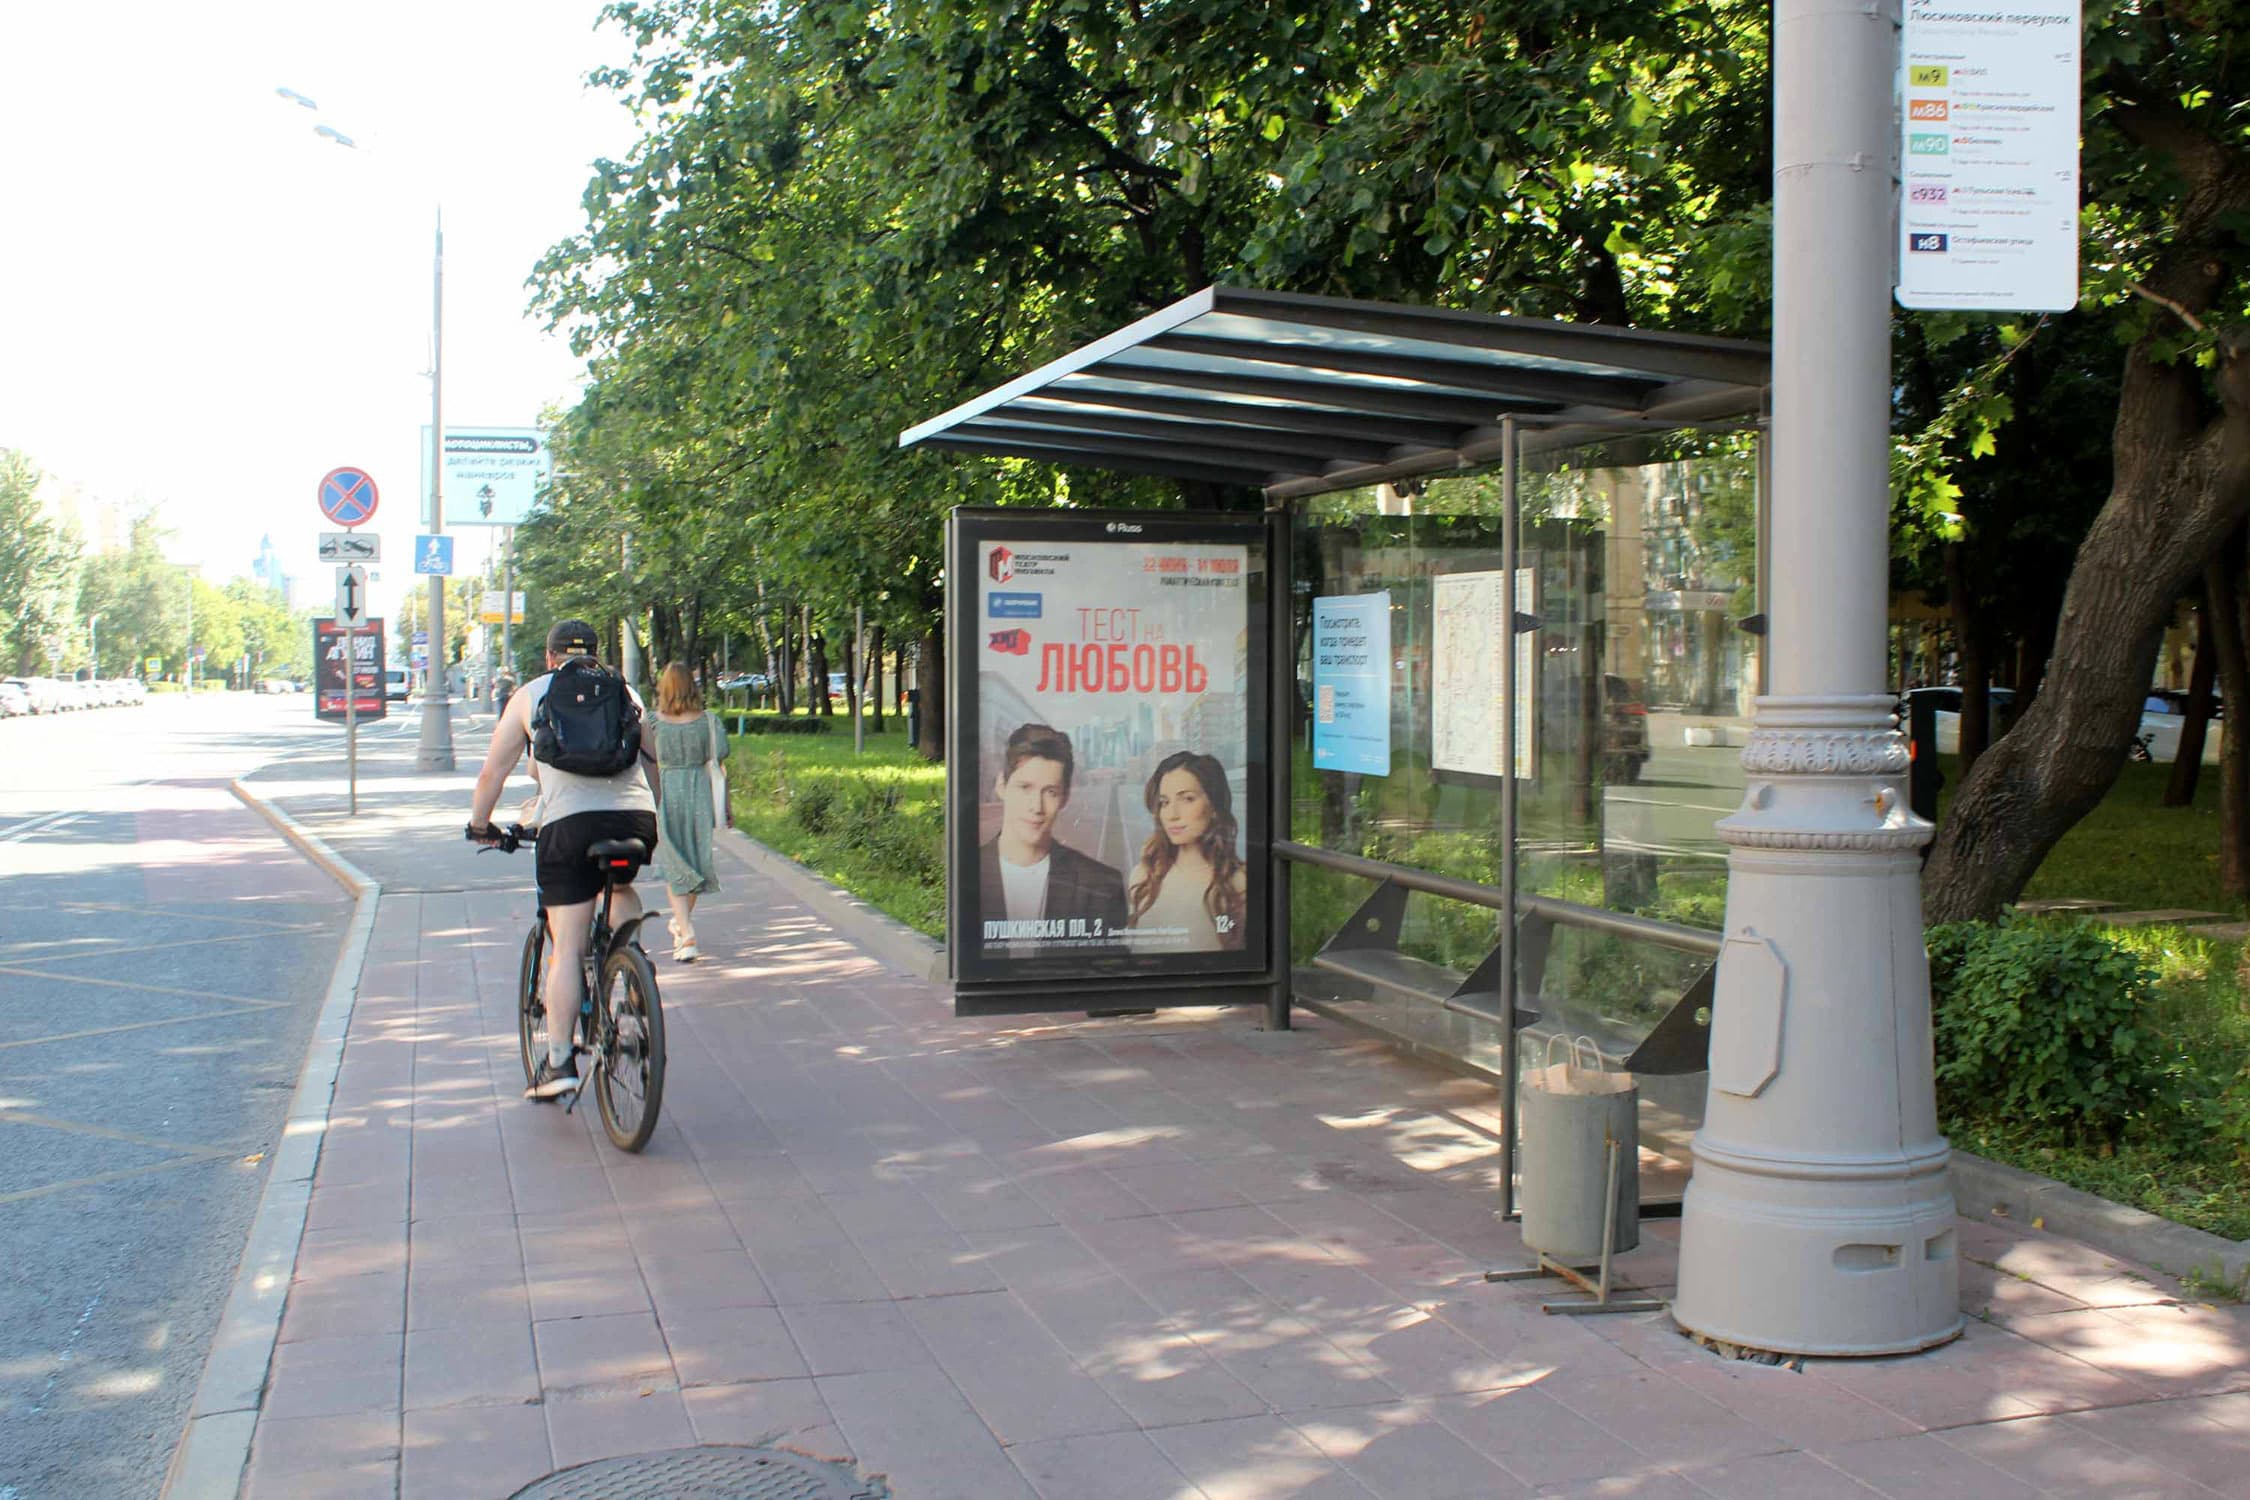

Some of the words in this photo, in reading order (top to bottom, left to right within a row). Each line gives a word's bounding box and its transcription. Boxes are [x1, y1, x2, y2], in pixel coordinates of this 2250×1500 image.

[2005, 14, 2072, 26] переулок
[1912, 104, 1946, 118] м86
[1912, 138, 1946, 152] м90
[1911, 188, 1946, 201] с932
[1077, 608, 1142, 642] ТЕСТ
[1036, 643, 1208, 694] ЛЮБОВЬ
[984, 918, 1066, 940] ПУШКИНСКАЯ
[1093, 917, 1103, 937] 2
[1215, 914, 1236, 934] 12+
